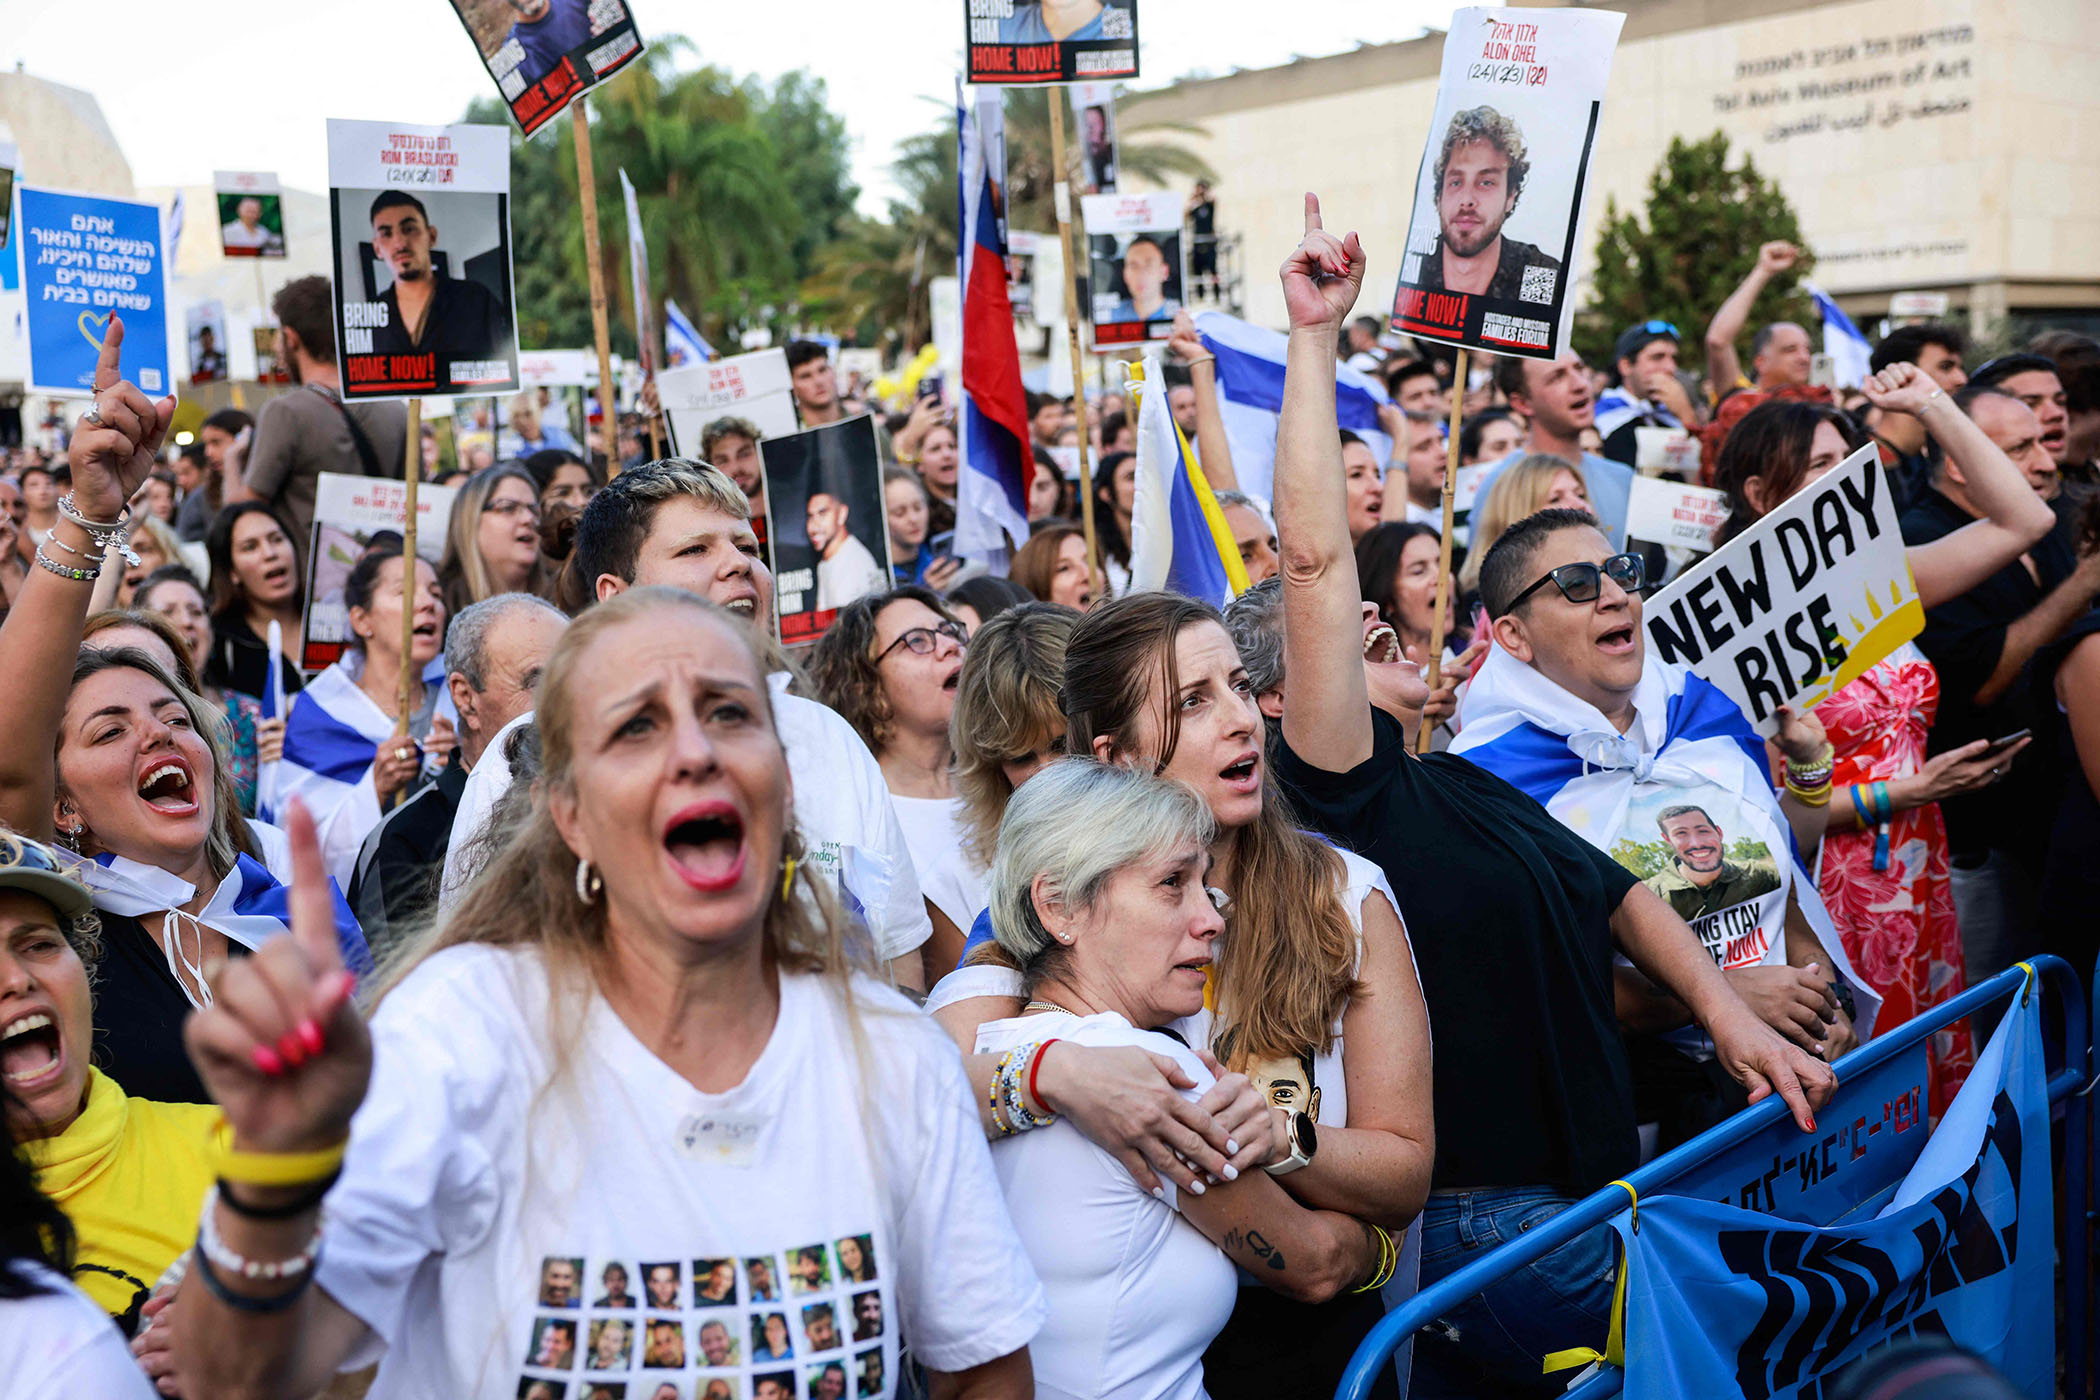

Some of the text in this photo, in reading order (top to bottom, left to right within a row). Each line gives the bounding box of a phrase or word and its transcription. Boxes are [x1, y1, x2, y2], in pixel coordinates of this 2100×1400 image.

[971, 19, 999, 44] HIM
[1515, 24, 1538, 43] אלון
[971, 47, 1014, 72] HOME
[1016, 42, 1061, 72] NOW!
[1482, 42, 1536, 63] ALON OHEL
[1798, 72, 1893, 99] Museum
[1903, 63, 1926, 87] of
[1931, 58, 1971, 81] Art
[381, 150, 401, 164] ROM
[71, 213, 115, 234] אתם
[30, 227, 155, 258] הנשימה והאור
[97, 254, 151, 275] שלהם
[56, 267, 137, 291] מאושרים
[42, 284, 151, 311] שאתם בבית
[1425, 293, 1469, 328] NOW!
[343, 301, 389, 328] BRING
[345, 328, 374, 354] HIM
[1481, 322, 1549, 347] FAMILIES FORUM
[348, 356, 388, 381] HOME
[390, 352, 435, 380] NOW!
[1648, 459, 1880, 665] NEW DAY
[1733, 593, 1848, 723] RISE
[1724, 902, 1759, 937] ITAY
